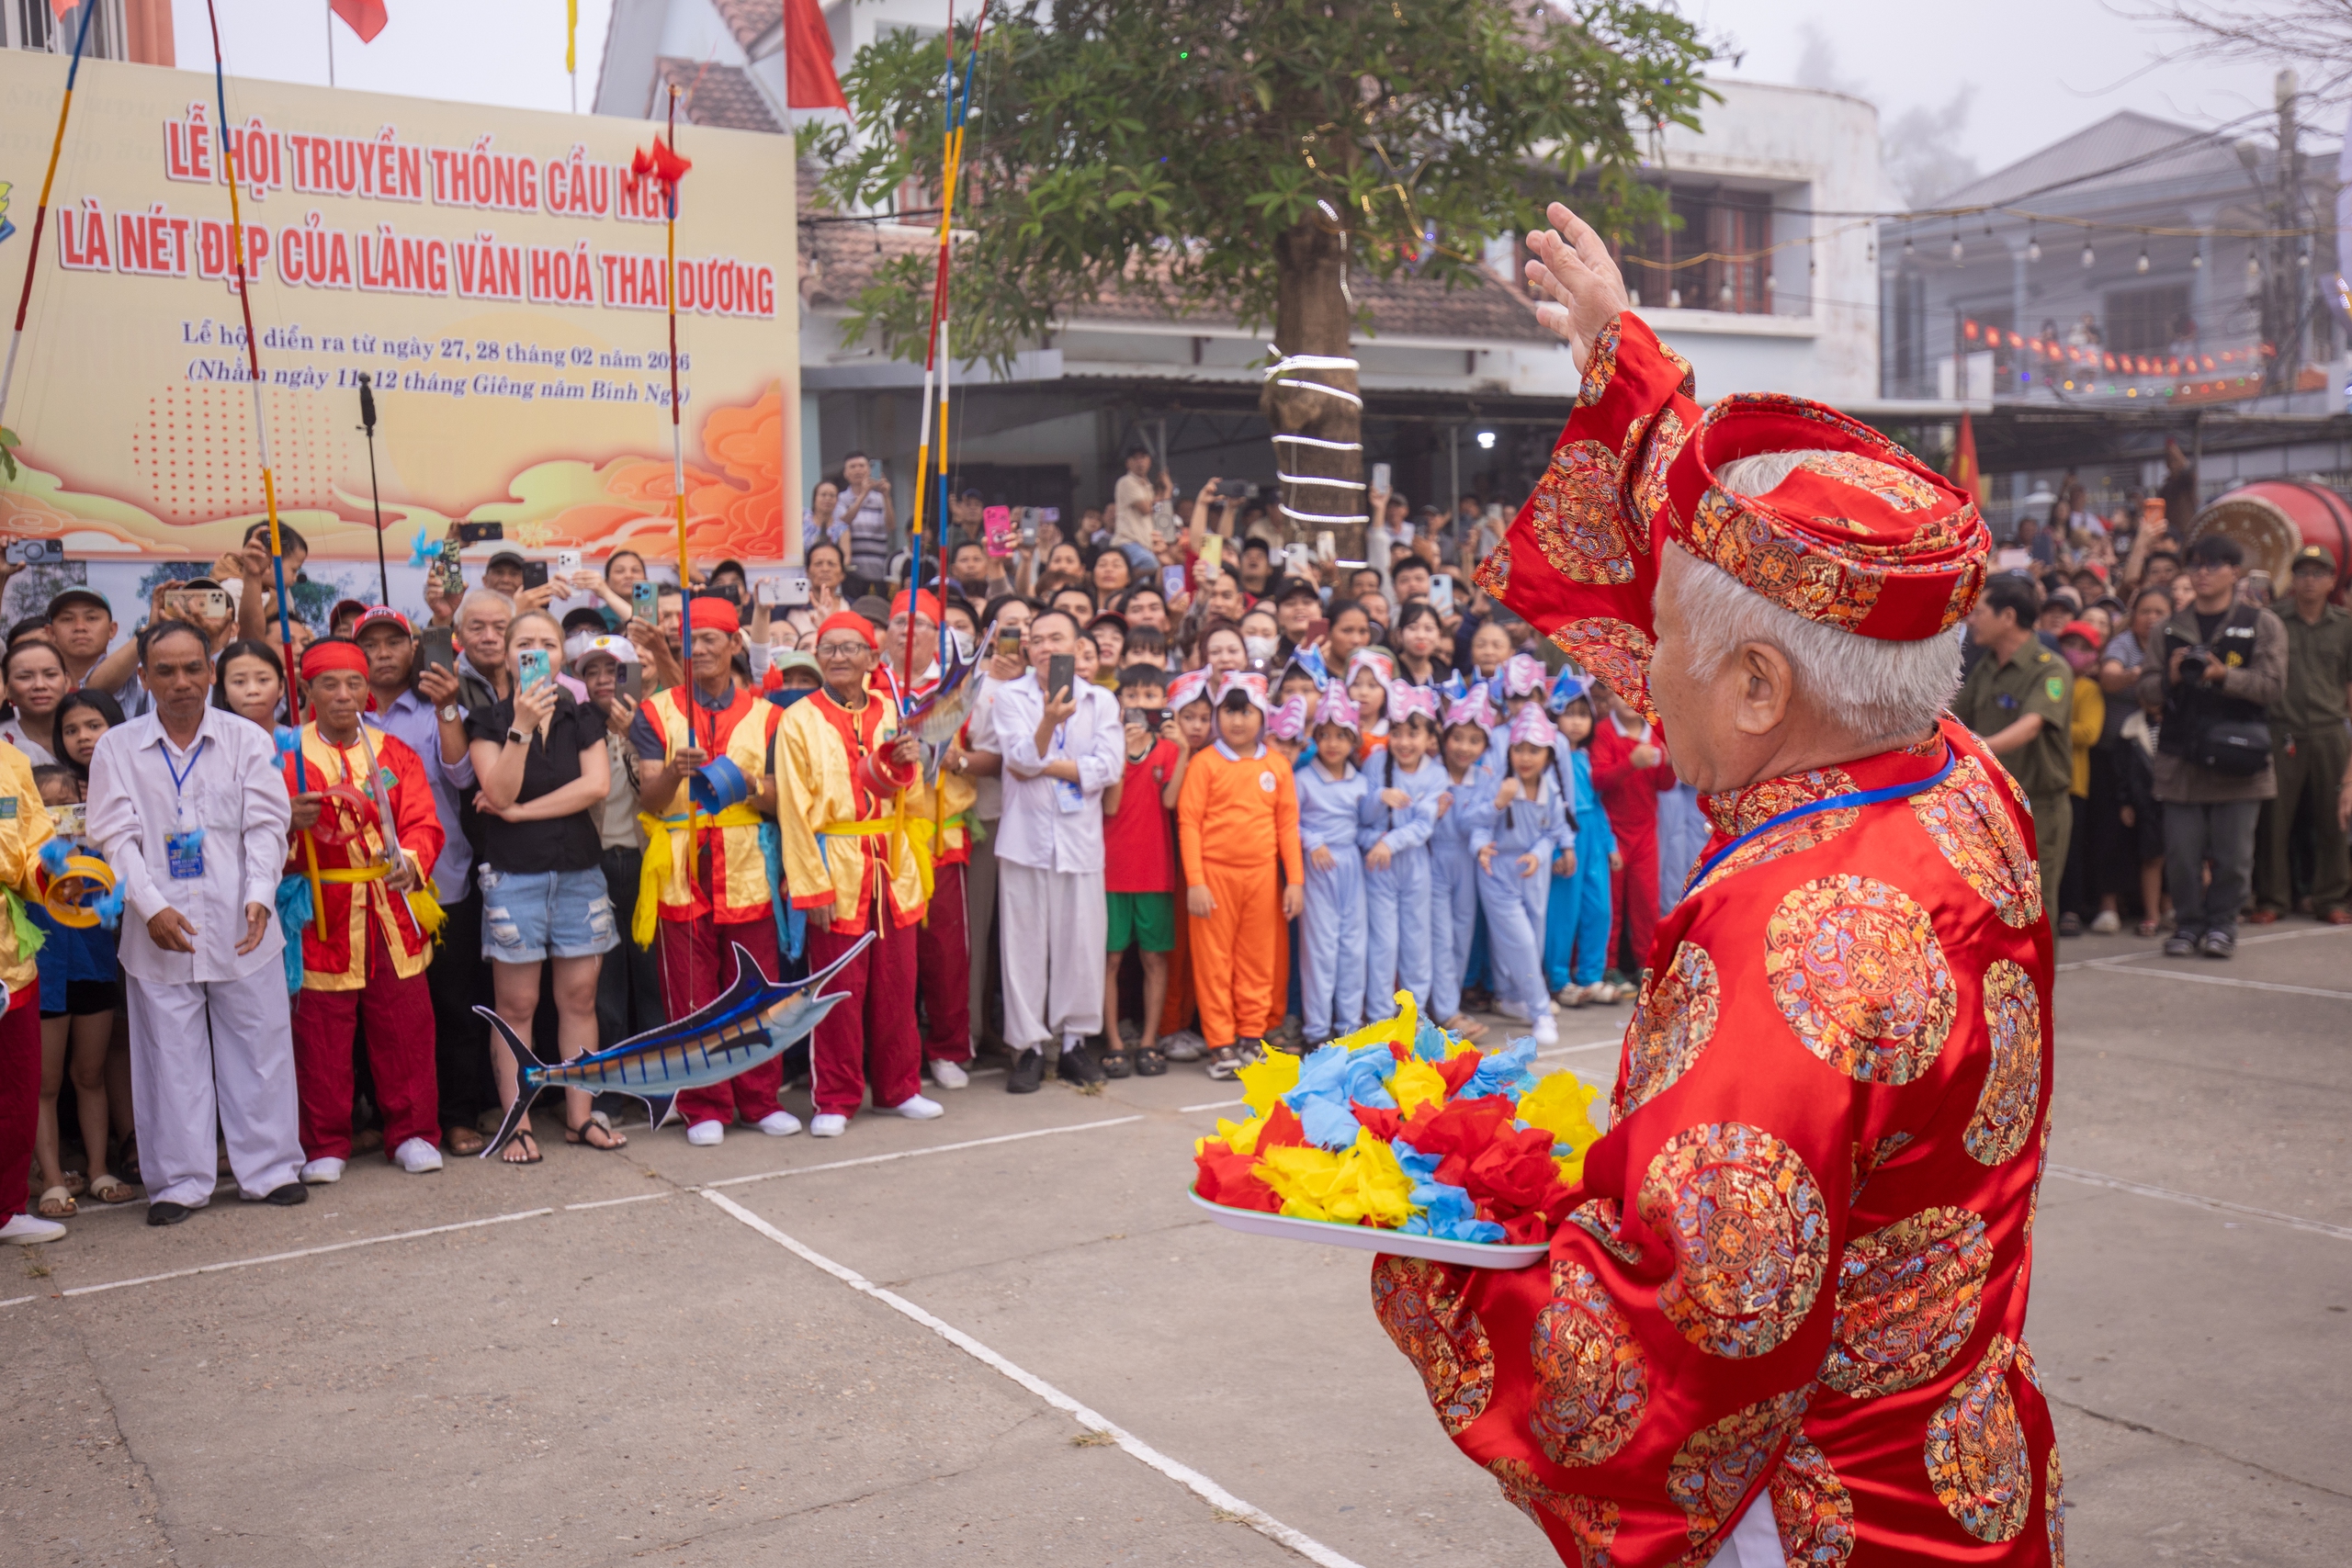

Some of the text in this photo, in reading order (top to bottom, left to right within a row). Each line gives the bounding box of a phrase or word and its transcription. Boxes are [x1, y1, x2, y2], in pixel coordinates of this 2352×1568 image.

[168, 103, 211, 179] LỄ
[223, 118, 281, 195] HỘI
[290, 126, 423, 198] TRUYỀN
[431, 134, 537, 209] THỐNG
[548, 145, 608, 215] CẦU
[63, 199, 774, 314] LÀ NÉT ĐẸP CỦA LÀNG VĂN HOÁ THAI DƯƠNG
[183, 319, 690, 371] Lễ hộ diễn ra từ ngày 27, 28 tháng 02 năm 206
[274, 365, 329, 390] ngày
[374, 369, 398, 389] 12
[404, 371, 467, 396] tháng
[472, 374, 535, 400] Giêng
[540, 378, 584, 400] năm
[591, 380, 638, 401] Bính
